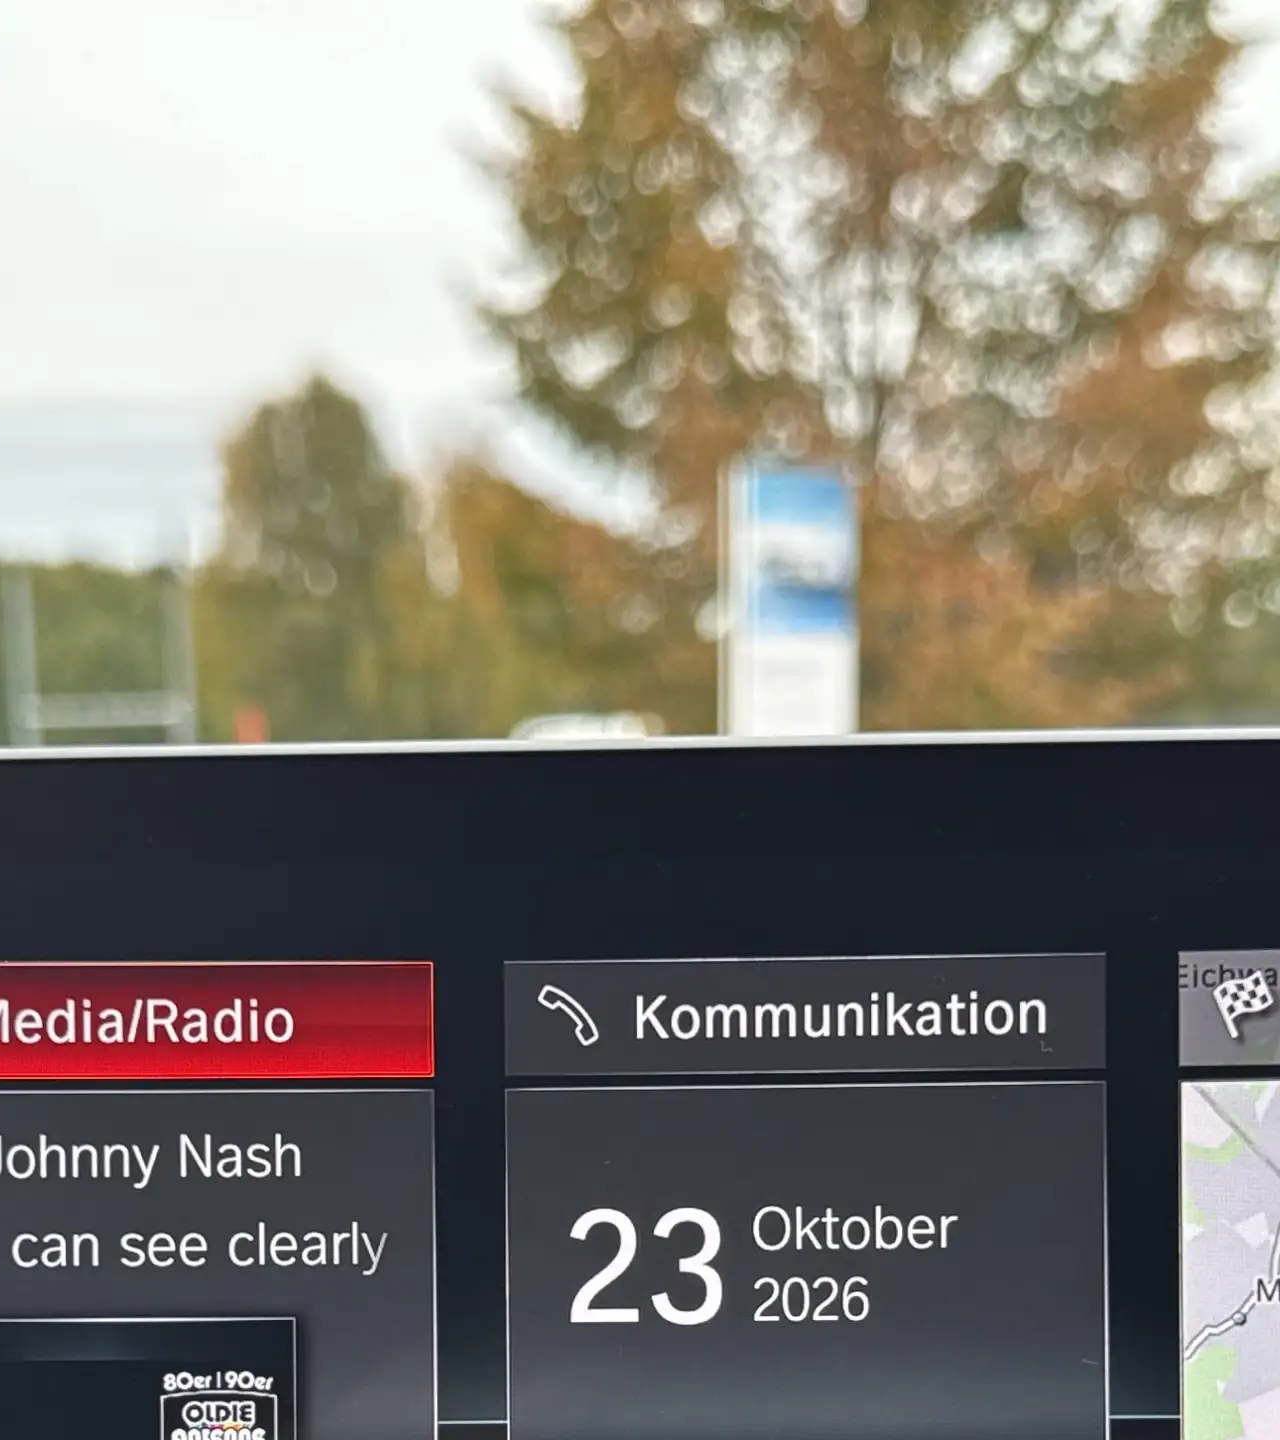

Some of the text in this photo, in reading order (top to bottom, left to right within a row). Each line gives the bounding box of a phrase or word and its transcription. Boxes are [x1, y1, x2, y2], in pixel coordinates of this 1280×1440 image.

[635, 990, 1047, 1041] Kommunikation
[178, 1133, 303, 1179] Nash
[10, 1231, 100, 1269] can
[119, 1231, 209, 1269] see
[227, 1220, 390, 1277] clearly
[751, 1205, 960, 1252] Oktober
[568, 1206, 724, 1327] 23
[752, 1275, 871, 1323] 2026
[163, 1371, 212, 1391] 80er
[224, 1370, 274, 1390] 90er
[183, 1402, 255, 1424] OLDIE
